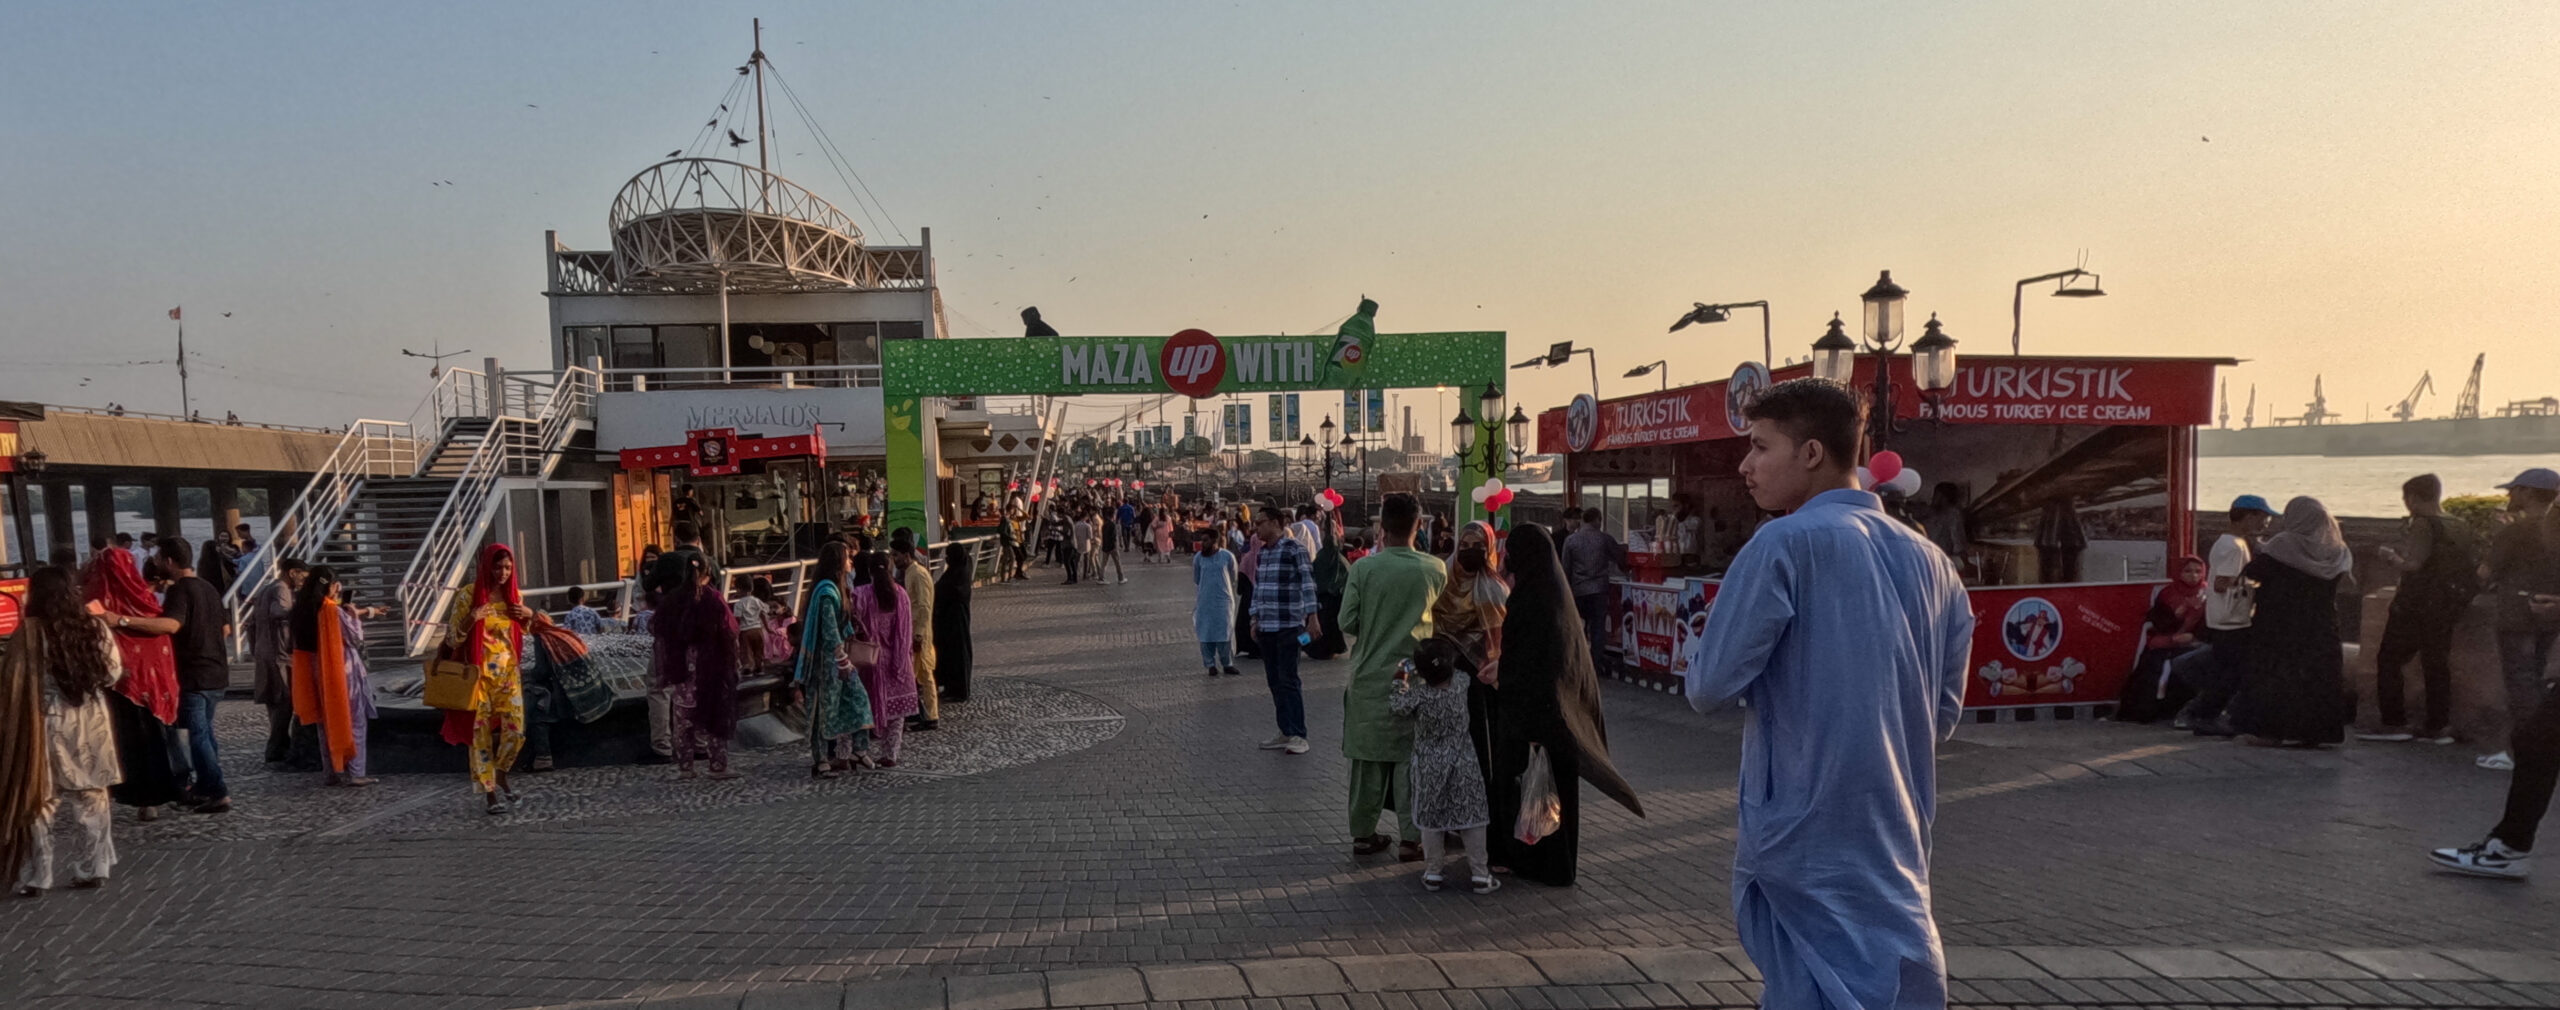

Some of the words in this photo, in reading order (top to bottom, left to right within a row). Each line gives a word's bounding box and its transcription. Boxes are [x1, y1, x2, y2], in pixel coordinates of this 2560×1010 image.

[1062, 343, 1153, 385] MAZA
[1233, 341, 1314, 383] WITH
[1616, 393, 1692, 429] TURKISTIK
[1994, 404, 2056, 420] TURKEY
[2060, 404, 2088, 419] ICE
[2093, 405, 2151, 421] CREAM
[1659, 428, 1672, 440] ICE
[1673, 424, 1699, 439] CREAM
